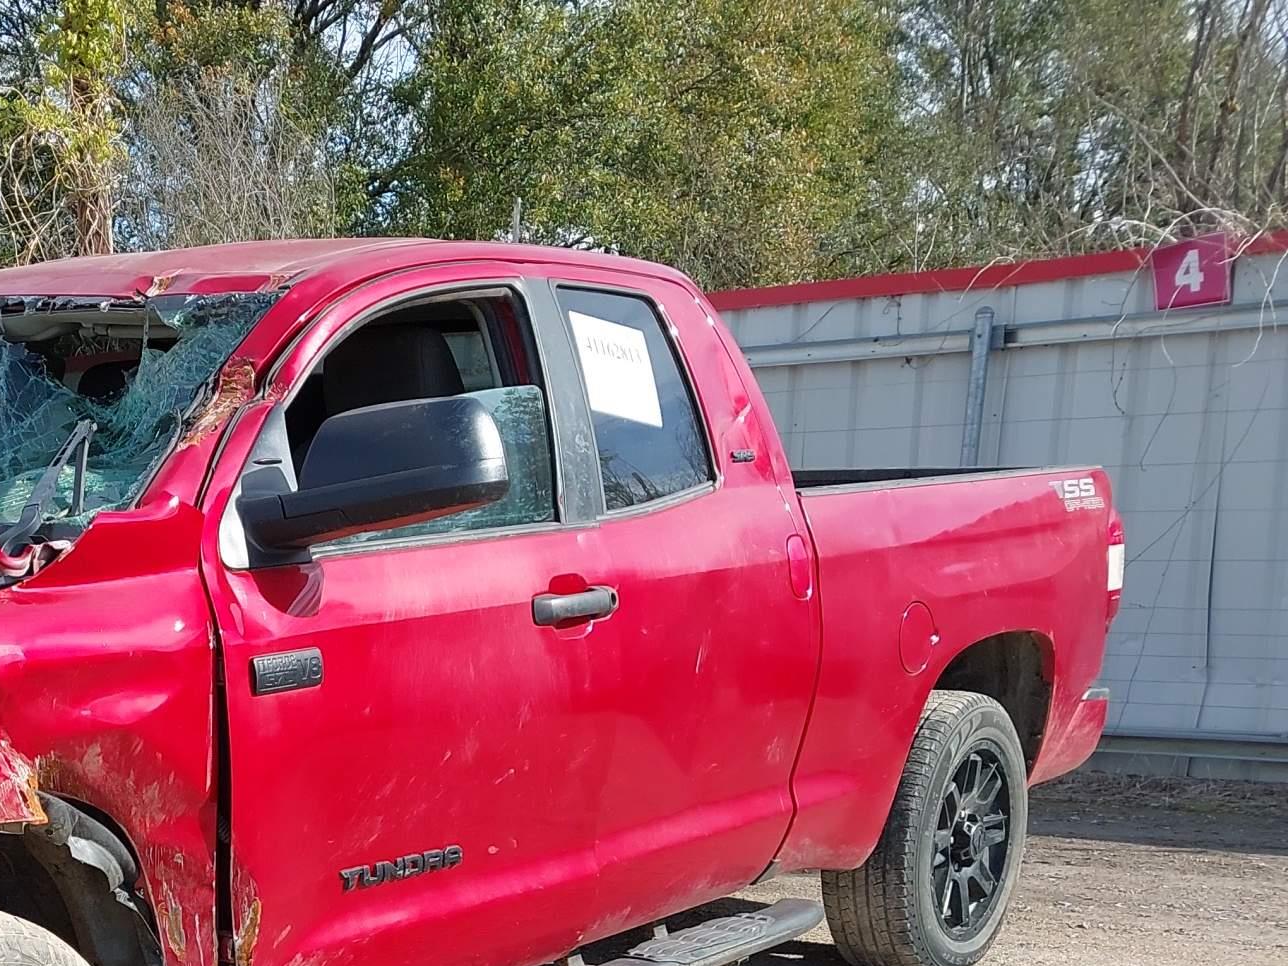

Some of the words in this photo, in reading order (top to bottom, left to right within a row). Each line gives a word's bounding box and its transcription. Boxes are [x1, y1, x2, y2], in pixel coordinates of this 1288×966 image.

[1175, 248, 1205, 293] 4
[1048, 478, 1095, 499] TSS
[340, 845, 463, 892] TUNDRA
